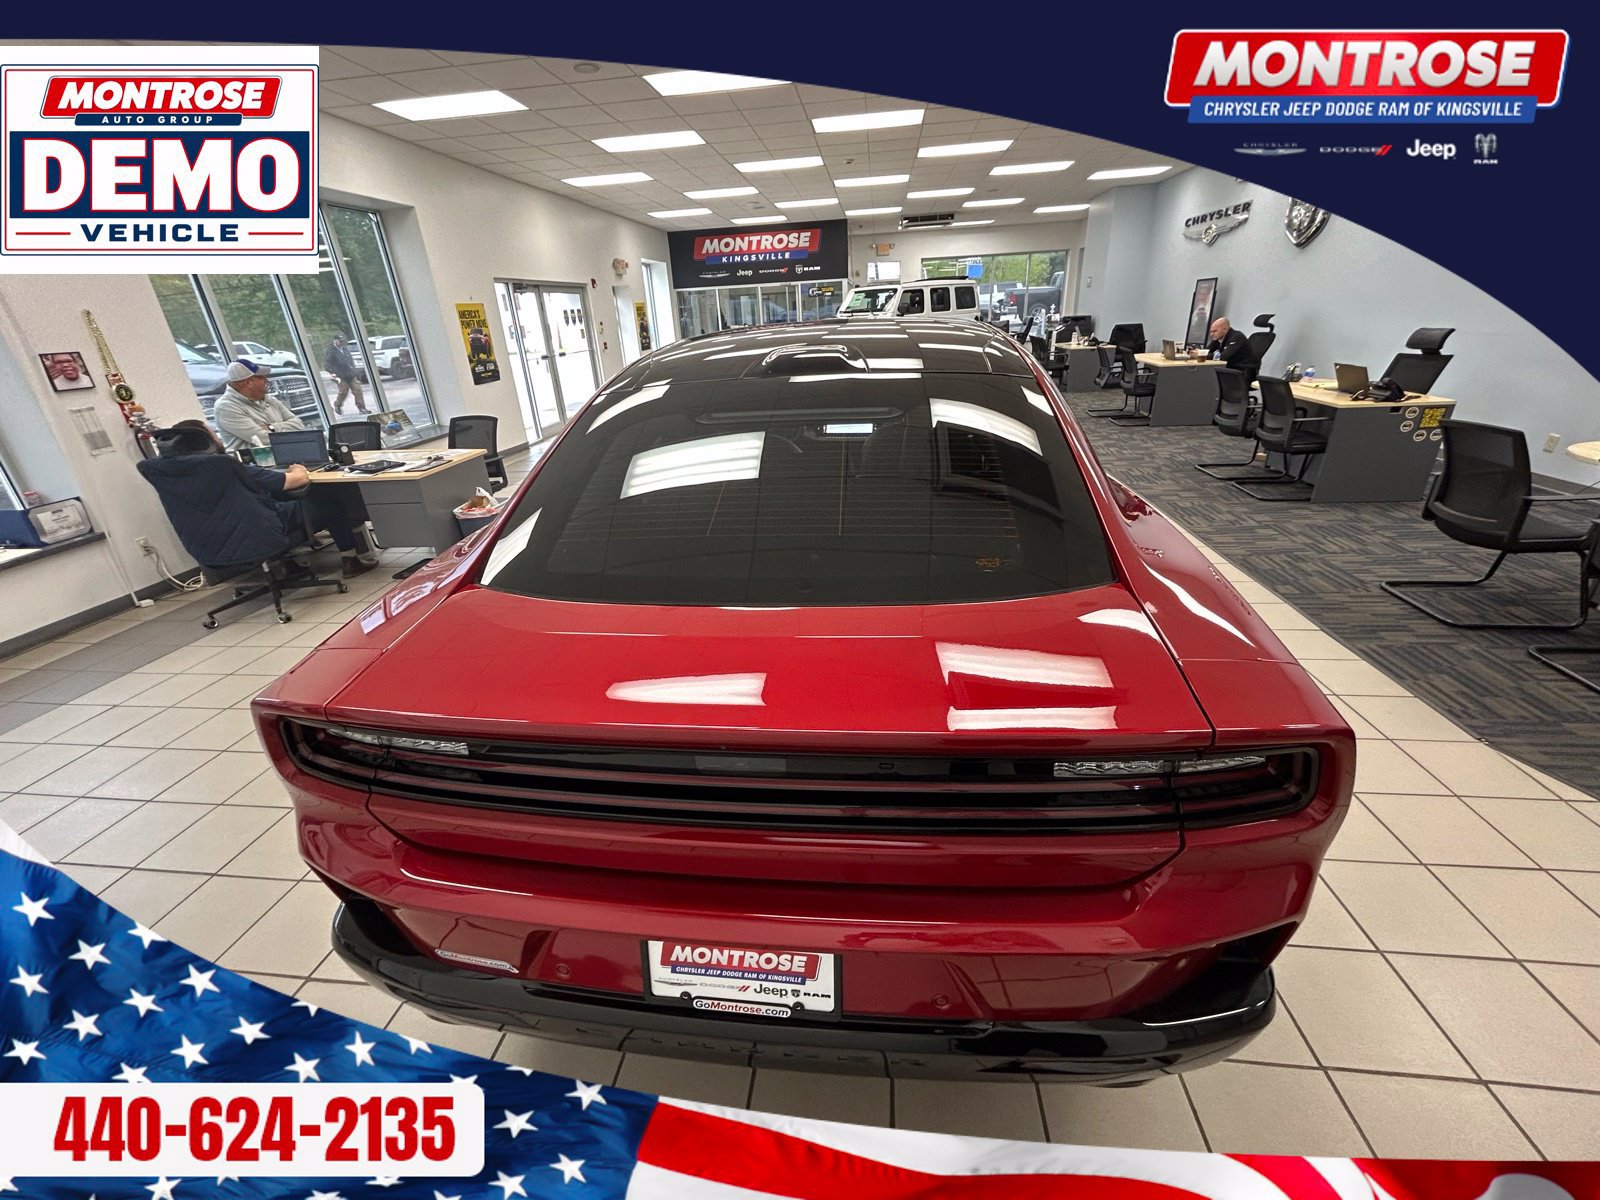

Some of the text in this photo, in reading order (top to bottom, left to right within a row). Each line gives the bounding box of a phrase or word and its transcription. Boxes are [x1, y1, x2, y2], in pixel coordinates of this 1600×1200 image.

[1184, 201, 1251, 227] CHRYSLER
[701, 231, 811, 254] MONTROSE
[722, 252, 790, 263] KINGSVILLE
[736, 268, 753, 277] Jeep
[670, 945, 808, 973] MONTROSE
[676, 966, 706, 975] CHRYSLER
[767, 974, 803, 983] KINGSVILLE
[753, 984, 788, 998] Jeep
[694, 999, 789, 1017] GoMontrose.com
